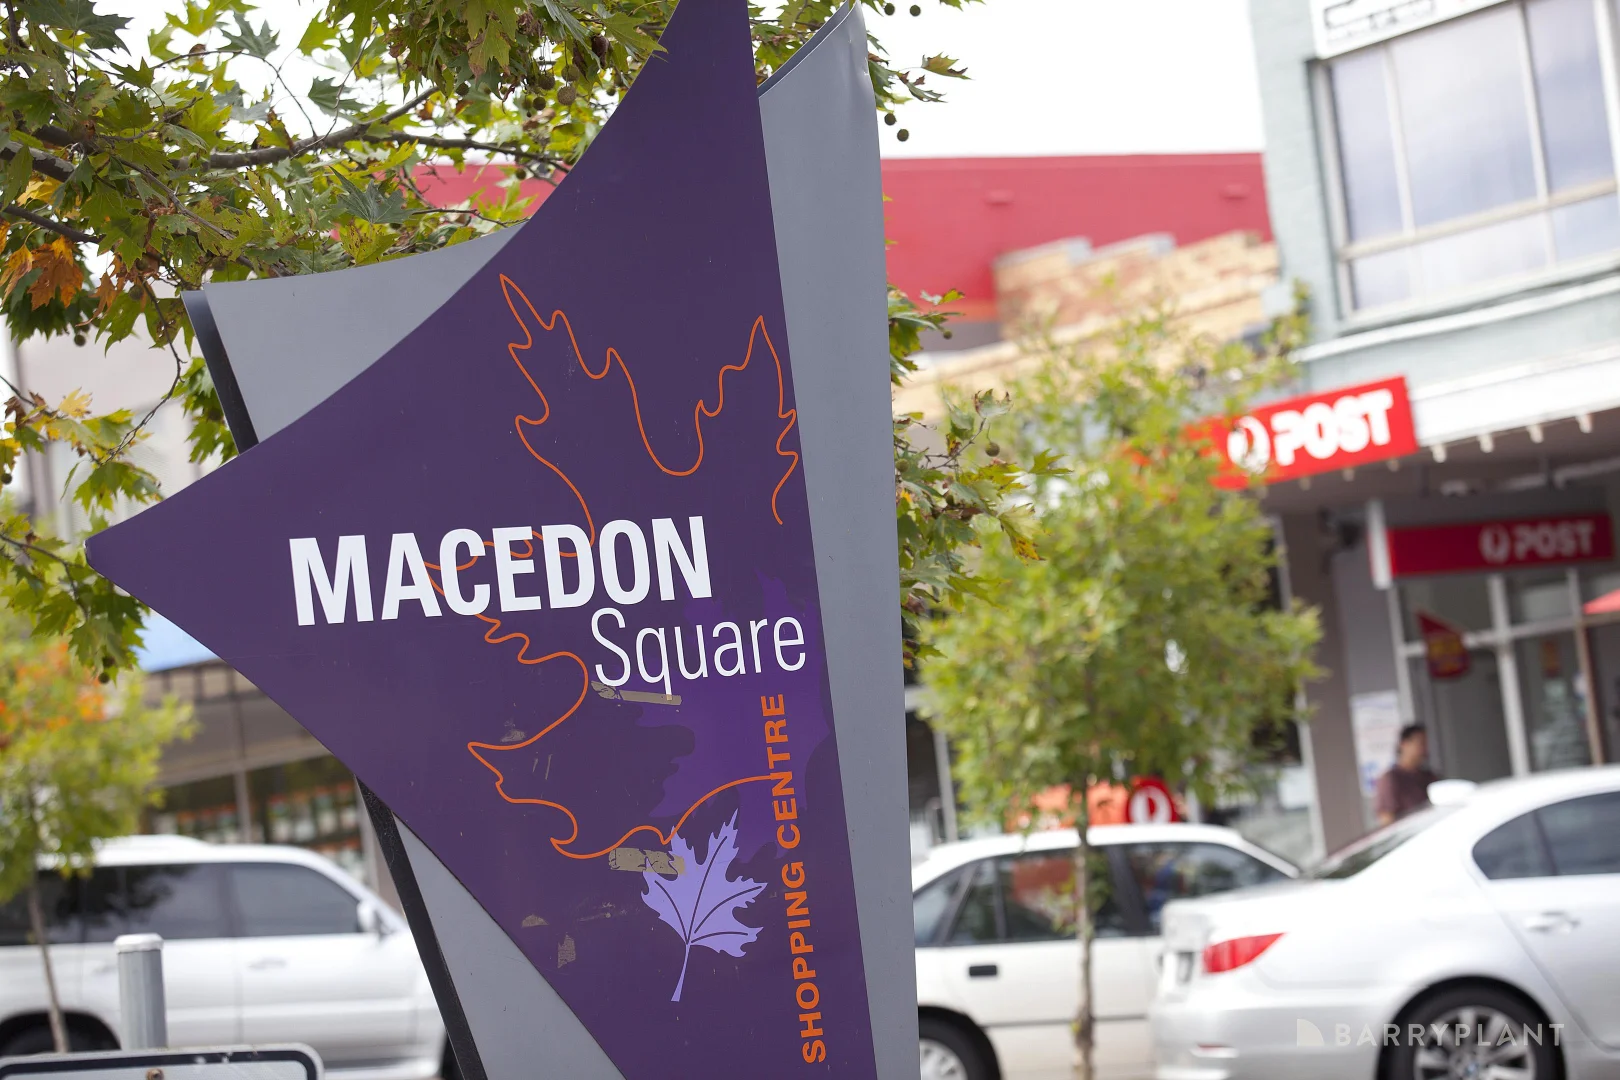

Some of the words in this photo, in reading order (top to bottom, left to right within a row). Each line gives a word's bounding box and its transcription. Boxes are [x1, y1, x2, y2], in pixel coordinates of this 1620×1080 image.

[1271, 388, 1393, 466] POST
[289, 515, 713, 626] MACEDON
[1513, 521, 1594, 560] POST
[591, 606, 806, 696] Square
[761, 694, 802, 849] CENTRE
[780, 861, 827, 1064] SHOPPING
